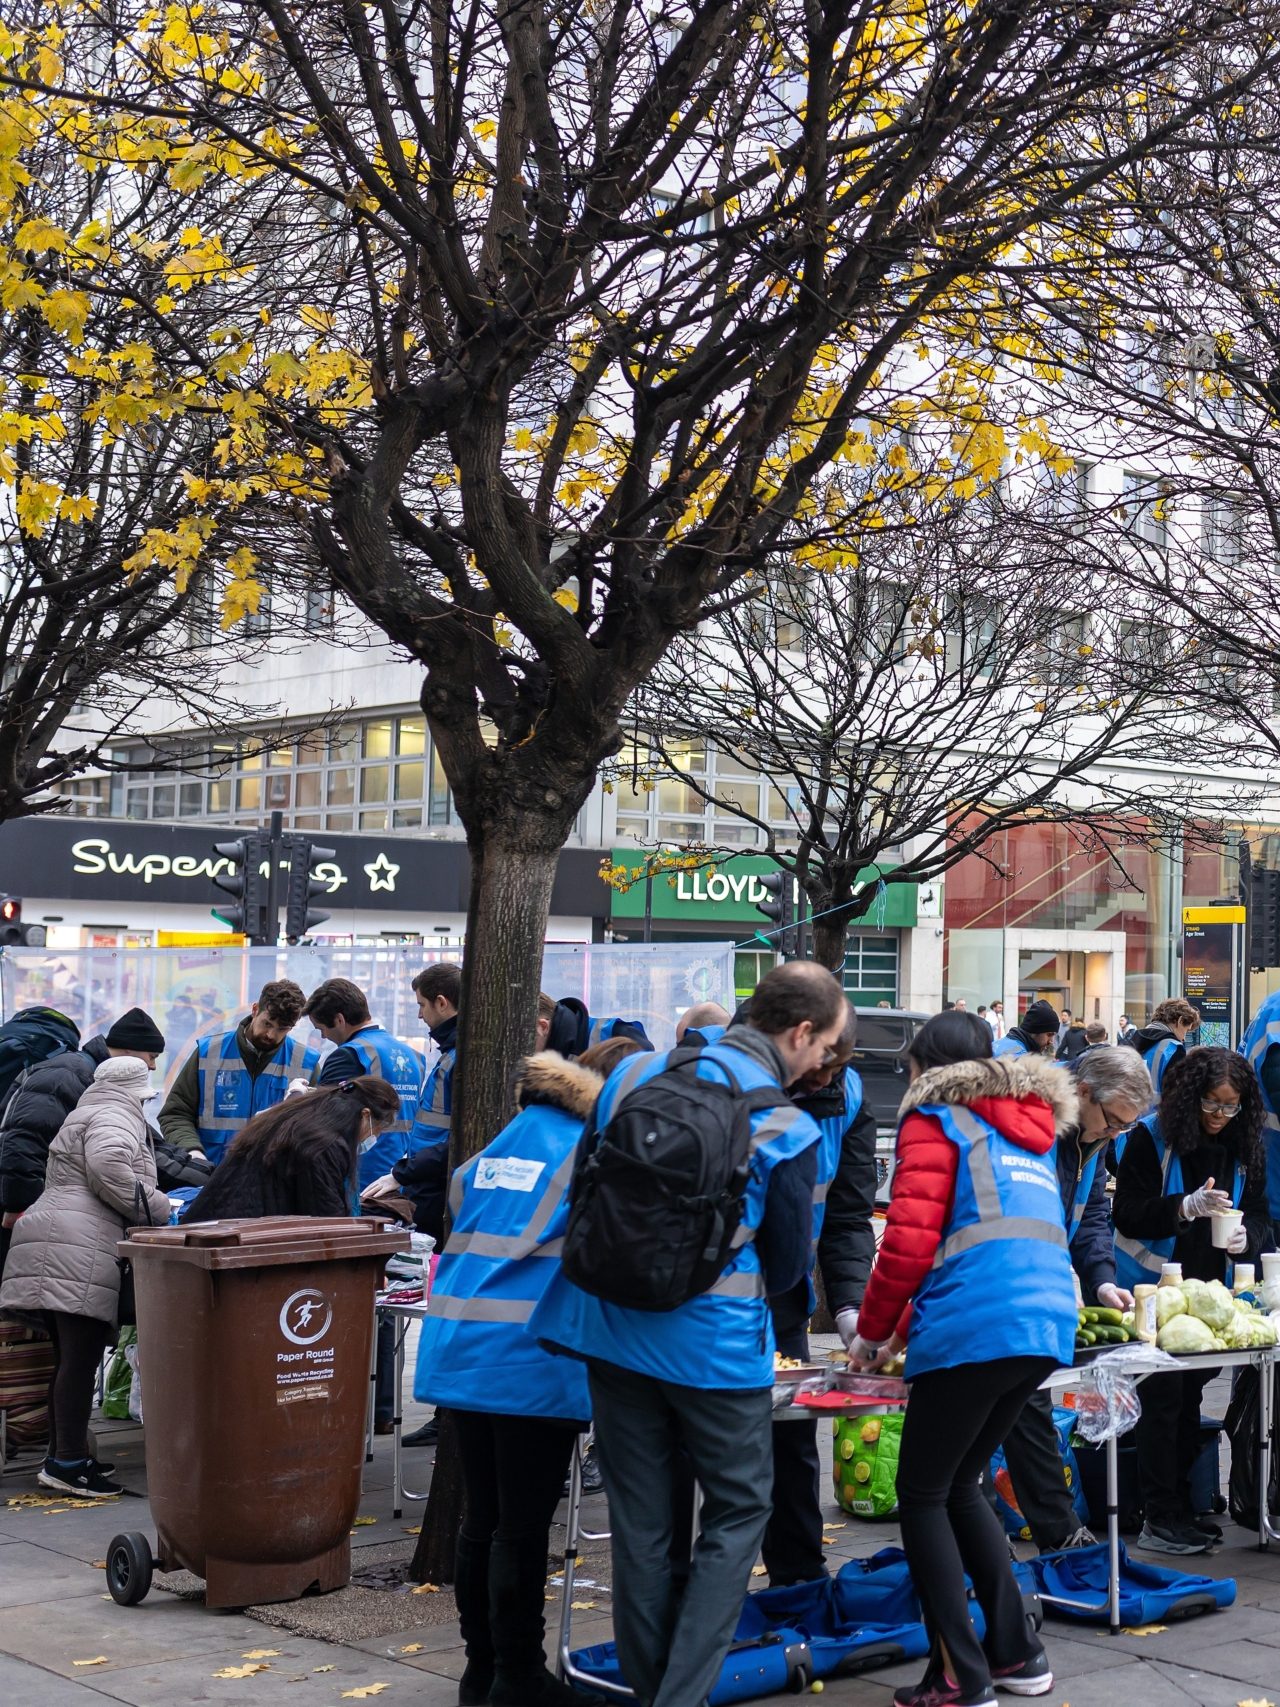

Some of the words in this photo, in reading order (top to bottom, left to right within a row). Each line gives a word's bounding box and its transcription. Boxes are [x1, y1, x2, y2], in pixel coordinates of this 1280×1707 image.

[677, 871, 774, 903] LLOYD
[277, 1353, 304, 1362] Paper
[306, 1348, 334, 1359] Round
[310, 1368, 334, 1377] Recycling
